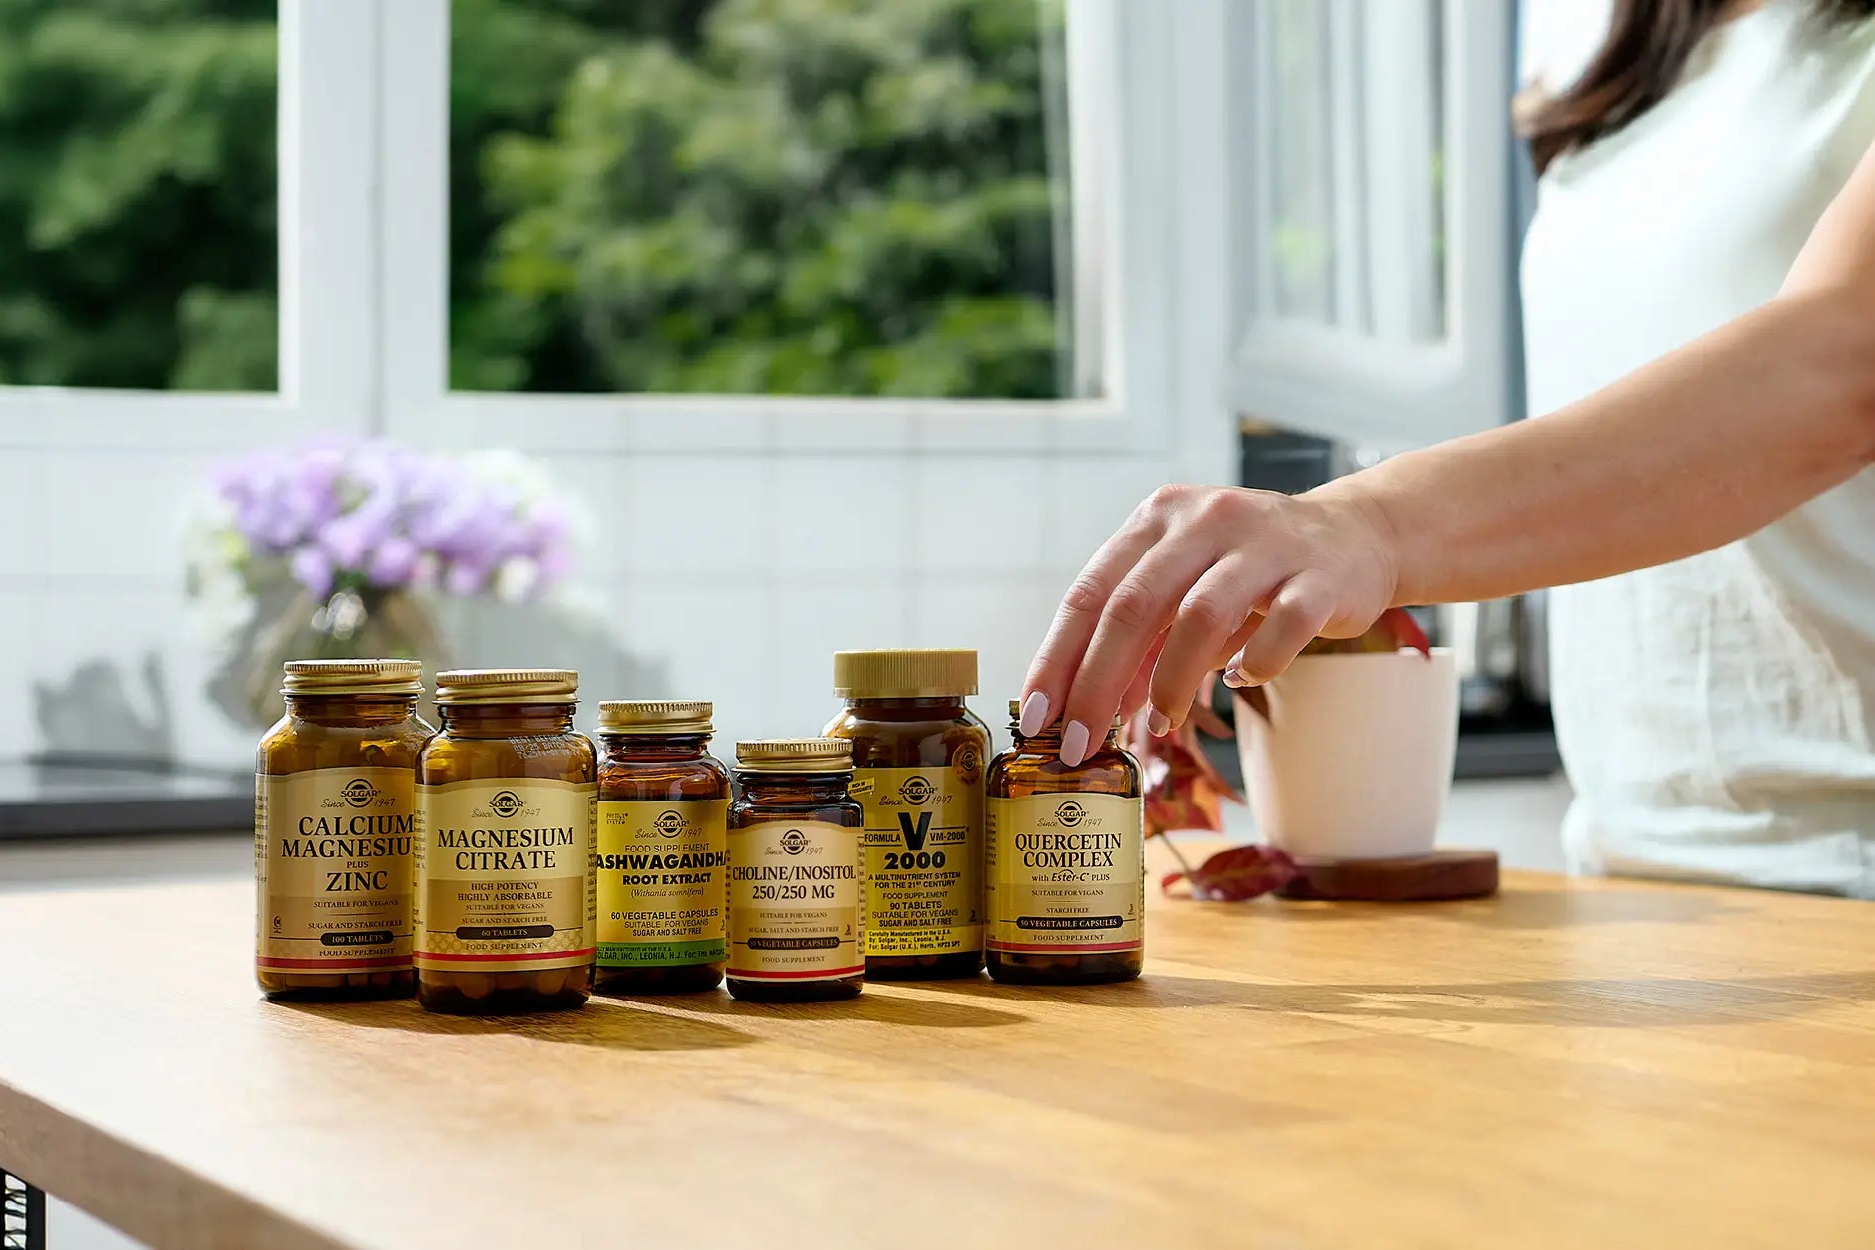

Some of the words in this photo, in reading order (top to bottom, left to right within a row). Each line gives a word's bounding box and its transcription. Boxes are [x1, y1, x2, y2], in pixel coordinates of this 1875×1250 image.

[341, 790, 377, 798] SOLGAR
[898, 787, 935, 795] SOLGAR
[321, 798, 345, 808] Since
[374, 798, 395, 807] 1947
[489, 800, 523, 808] SOLGAR
[879, 796, 902, 806] Since
[932, 796, 952, 804] 1947
[471, 808, 493, 818] Since
[520, 808, 541, 816] 1947
[299, 814, 414, 836] CALCIUM
[1037, 818, 1057, 827] Since
[1083, 818, 1102, 826] 1947
[635, 829, 657, 839] Since
[683, 828, 702, 837] 1947
[864, 833, 900, 842] FORMULA
[898, 812, 932, 850] V
[930, 831, 965, 841] VM-2000
[438, 827, 574, 848] MAGNESIUM
[1015, 833, 1122, 851] QUERCETIN
[282, 837, 411, 858] MAGNESIU
[653, 843, 710, 852] SUPPLEMENT
[765, 847, 783, 855] Since
[806, 847, 823, 855] 1947
[456, 850, 556, 870] CITRATE
[597, 851, 725, 870] ASHWAGANDH
[884, 851, 945, 870] 2000
[1024, 851, 1113, 868] COMPLEX
[733, 865, 856, 882] CHOLINE/INOSITOL
[1032, 874, 1049, 882] with
[326, 870, 388, 892] ZINC
[622, 875, 658, 885] ROOT
[662, 872, 712, 884] EXTRACT
[471, 882, 494, 891] HIGH
[496, 882, 539, 890] POTENCY
[458, 893, 491, 901] HIGHLY
[493, 891, 553, 900] ABSORBABLE
[631, 889, 666, 898] (Withania
[752, 885, 806, 901] 250/250
[812, 885, 835, 898] MG
[904, 891, 948, 899] SUPPLEMENT
[466, 903, 499, 911] SUITABLE
[902, 901, 942, 909] TABLETS
[611, 912, 620, 920] 60
[622, 911, 676, 920] VEGETABLE
[679, 908, 718, 918] CAPSULES
[929, 909, 958, 917] VEGANS
[682, 919, 709, 927] VEGANS
[1079, 919, 1117, 927] CAPSULES
[633, 929, 655, 937] SUGAR
[332, 935, 344, 943] 100
[490, 942, 544, 950] SUPPLEMENT
[802, 940, 838, 948] CAPSULES
[343, 948, 395, 956] SUPPLEMENT
